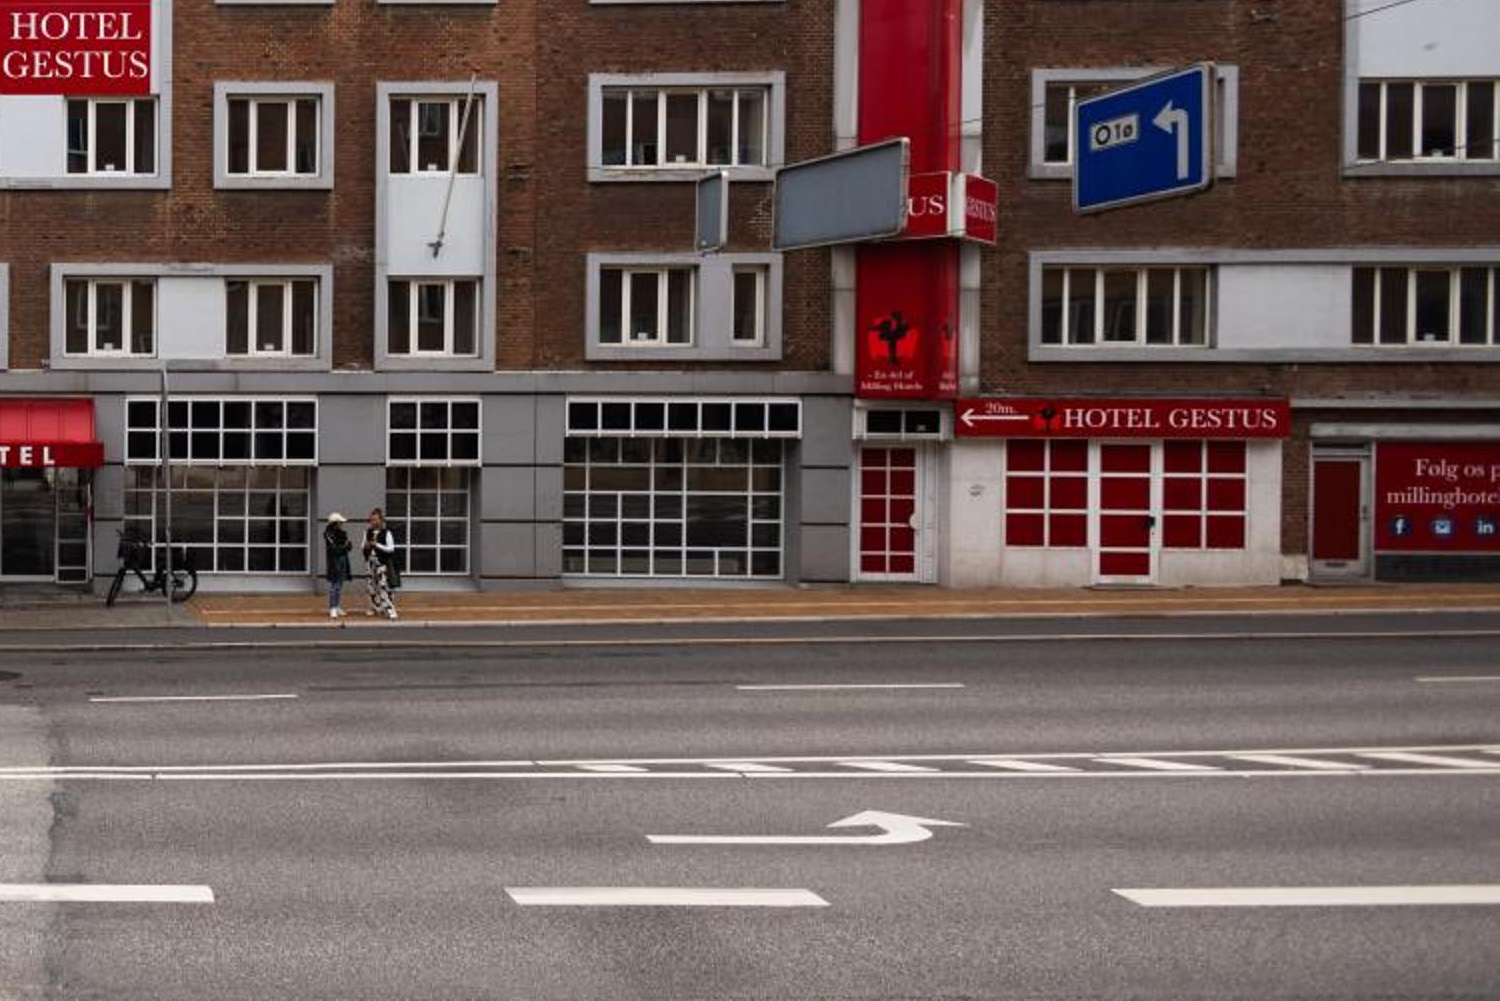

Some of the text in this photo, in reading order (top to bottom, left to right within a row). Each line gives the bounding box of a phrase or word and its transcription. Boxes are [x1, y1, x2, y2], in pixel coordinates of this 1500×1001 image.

[10, 12, 142, 40] HOTEL
[3, 50, 148, 79] GESTUS
[1064, 407, 1277, 429] HOTEL GESTUS
[1387, 486, 1500, 510] millinghote
